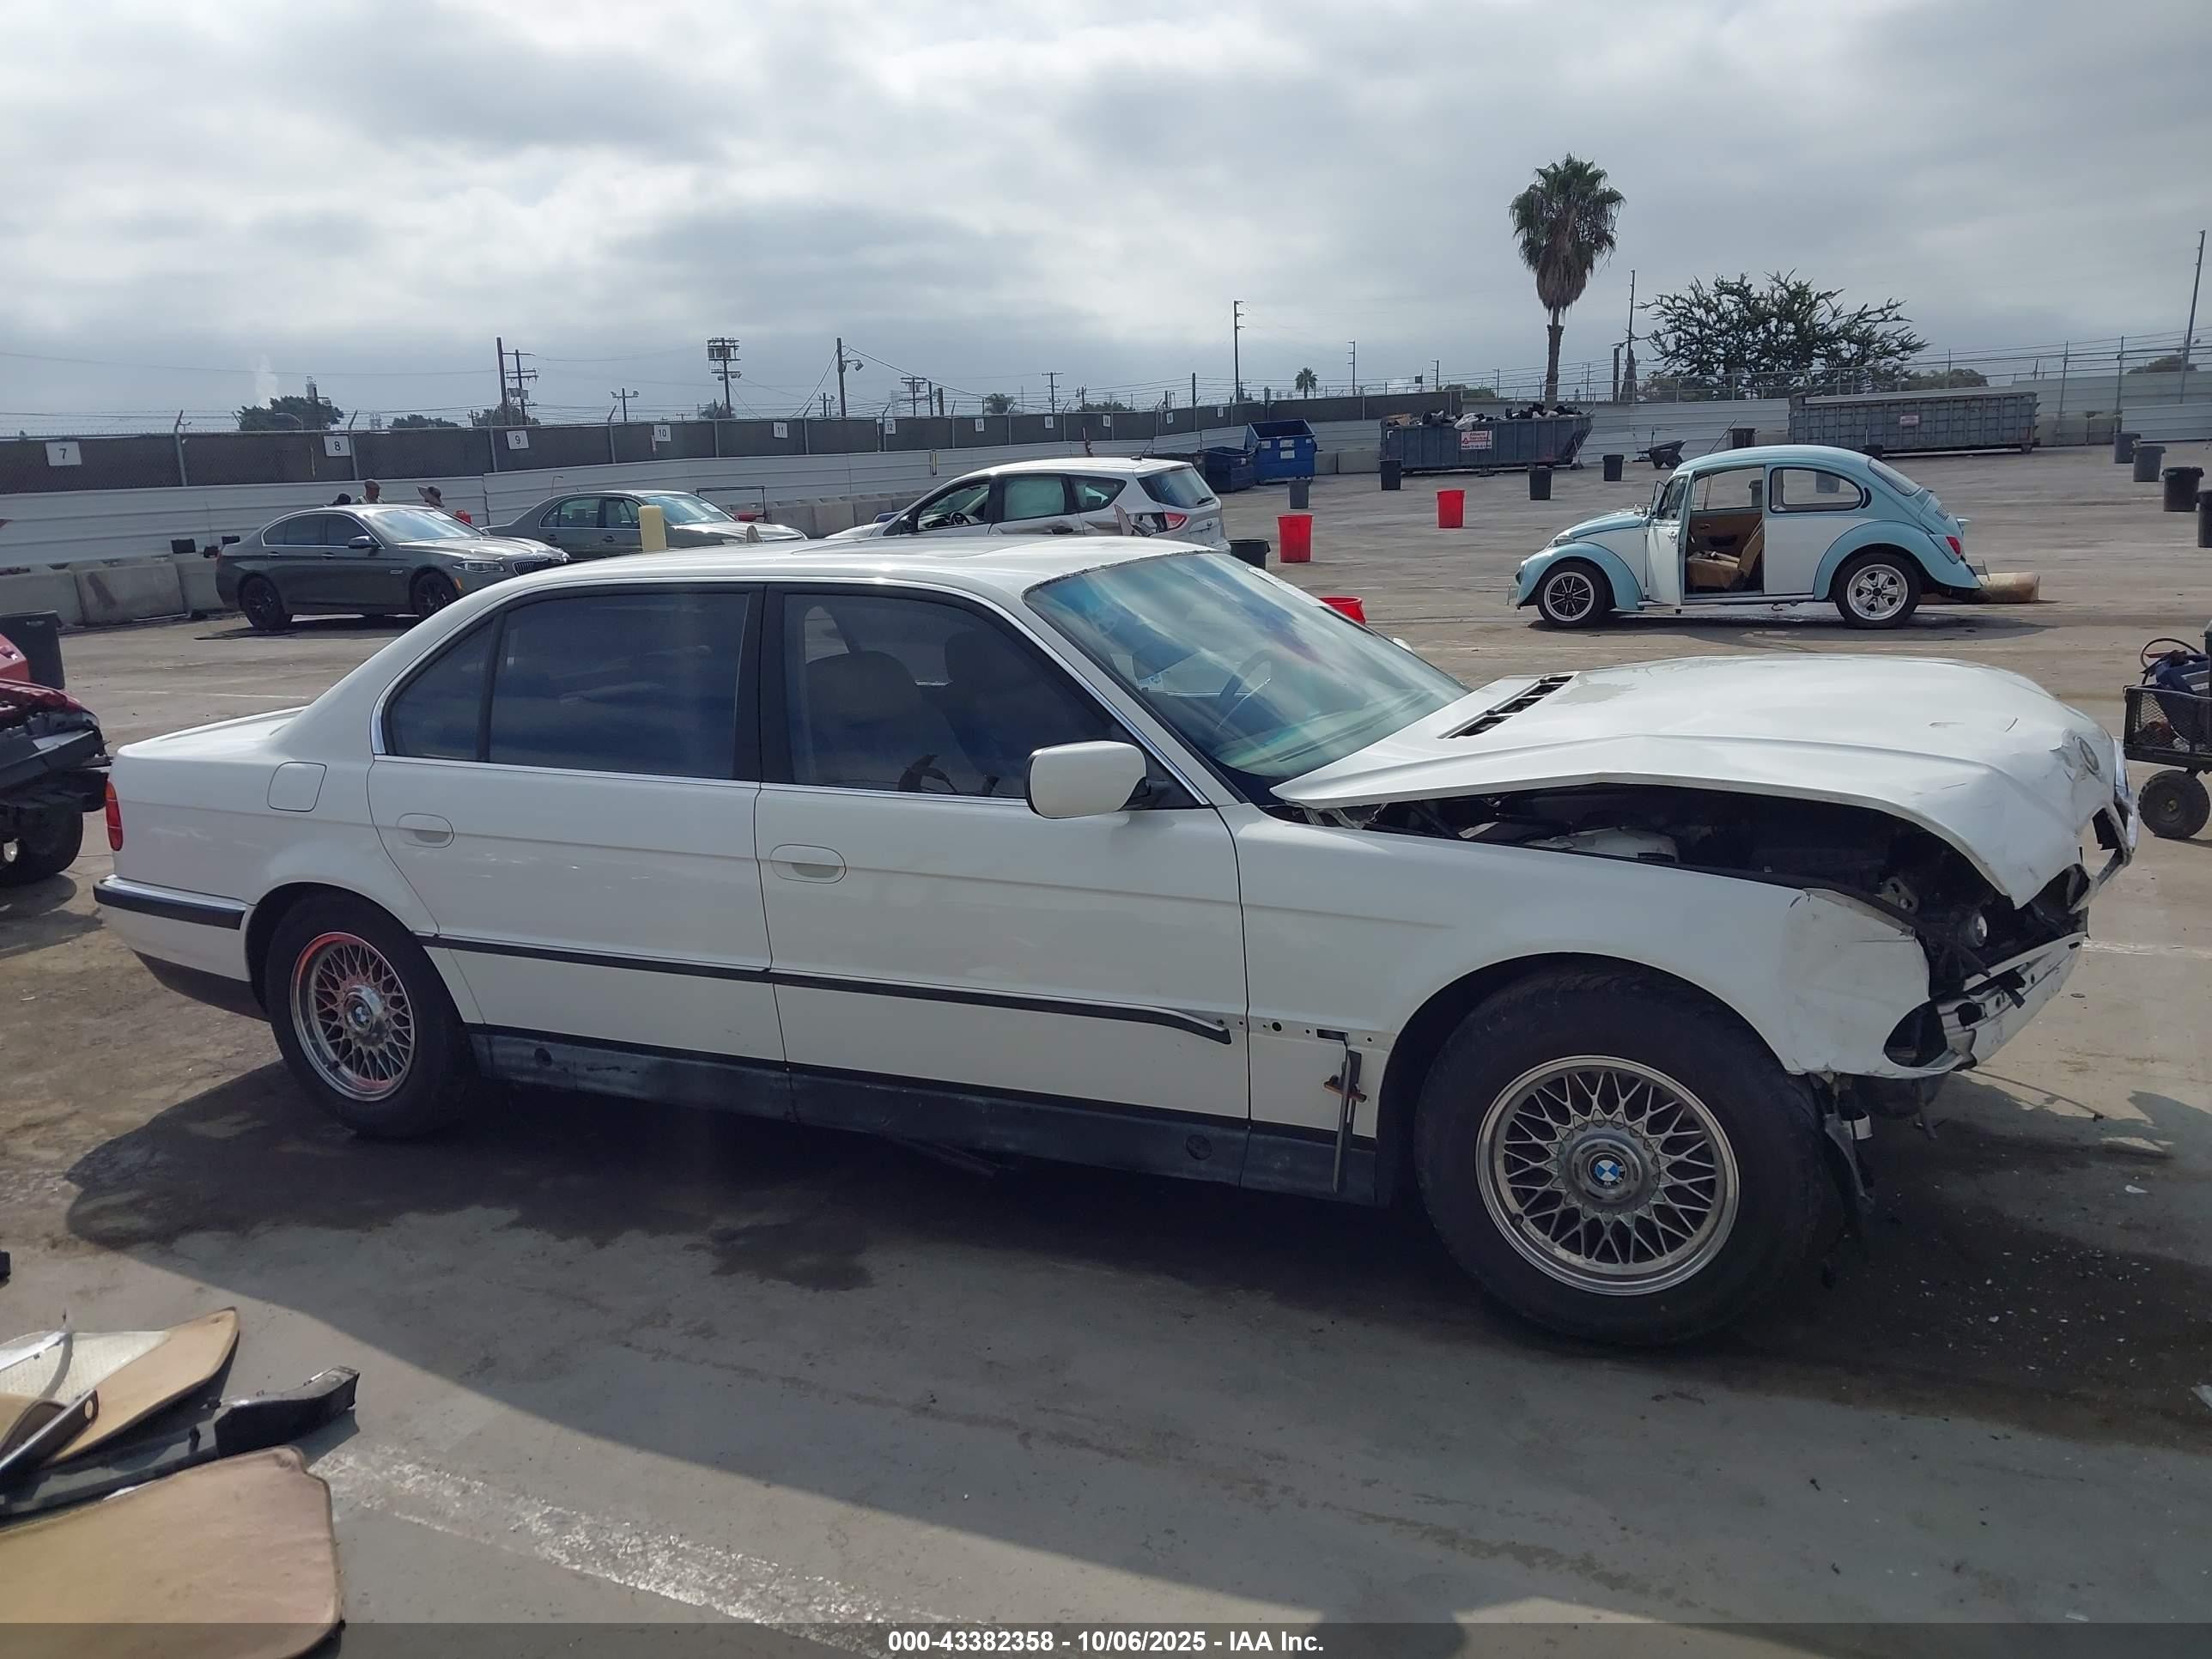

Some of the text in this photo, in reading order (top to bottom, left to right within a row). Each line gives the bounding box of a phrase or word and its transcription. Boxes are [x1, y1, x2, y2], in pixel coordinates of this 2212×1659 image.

[658, 428, 667, 438] 10
[776, 426, 785, 435] 11
[514, 434, 521, 445] 9
[334, 441, 341, 452] 8
[58, 447, 67, 460] 7
